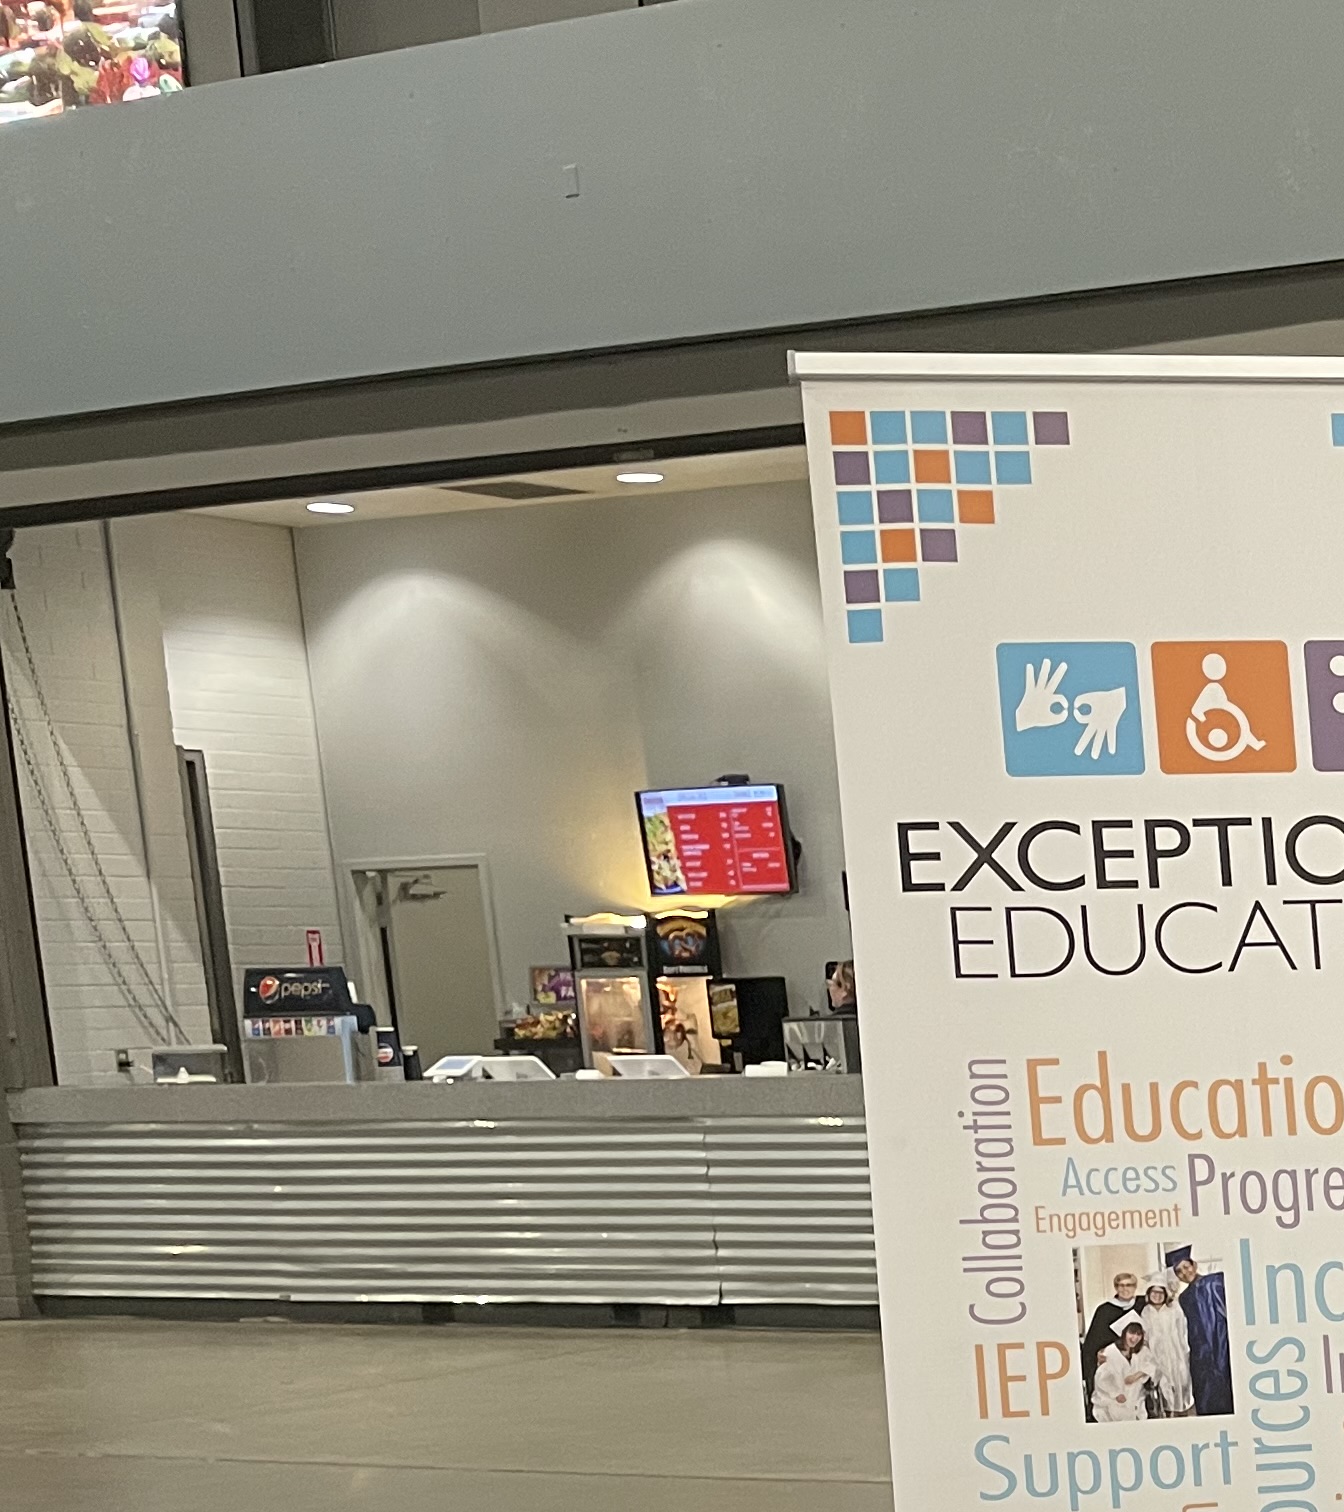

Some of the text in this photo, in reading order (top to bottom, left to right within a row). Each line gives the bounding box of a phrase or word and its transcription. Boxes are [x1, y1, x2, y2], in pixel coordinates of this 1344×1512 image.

[281, 979, 324, 999] pepsi
[957, 1057, 1026, 1326] Collaboration
[1061, 1156, 1179, 1198] Access
[1034, 1202, 1181, 1240] Engagement
[973, 1340, 1072, 1420] IEP
[973, 1429, 1239, 1512] Support
